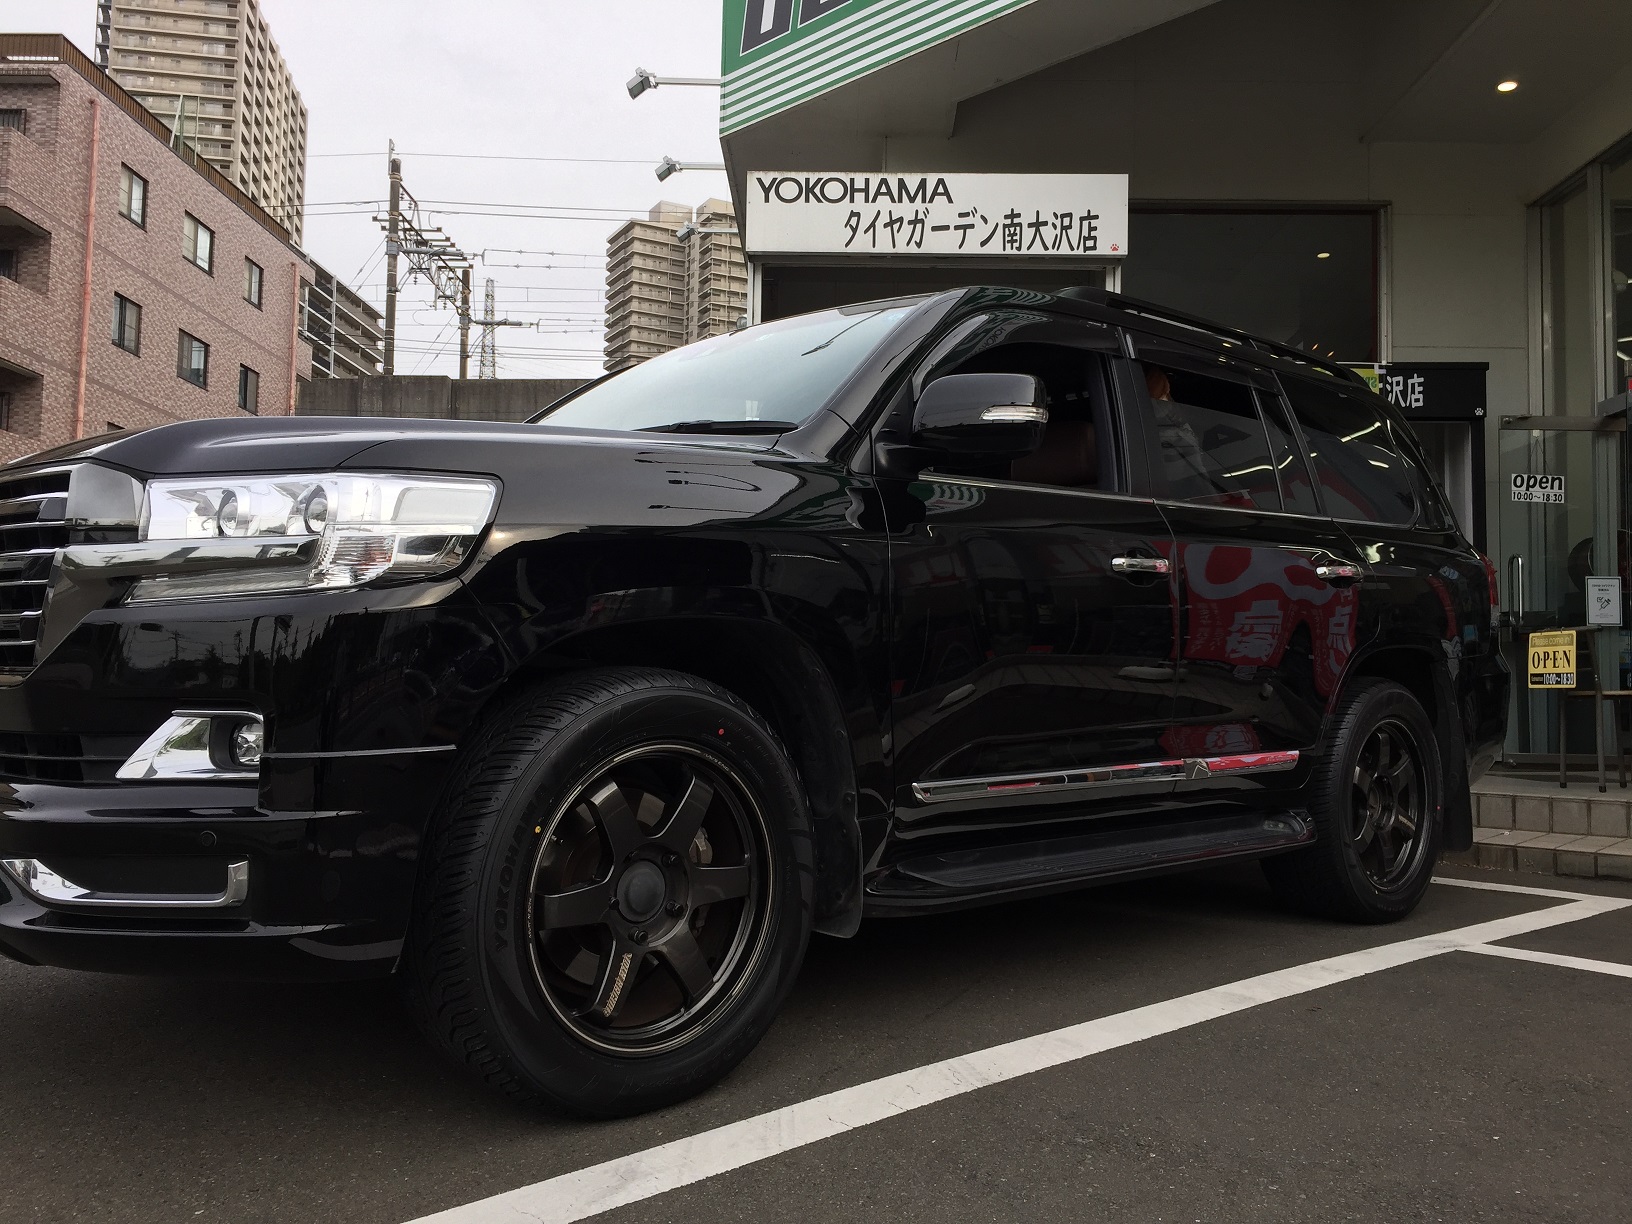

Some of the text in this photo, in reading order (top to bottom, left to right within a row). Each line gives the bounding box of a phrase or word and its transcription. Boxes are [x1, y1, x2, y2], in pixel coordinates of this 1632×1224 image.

[756, 177, 954, 204] YOKOHAMA
[844, 206, 1099, 254] タイヤガーデン南大沢店
[1379, 373, 1424, 408] 沢店
[1513, 474, 1563, 491] open
